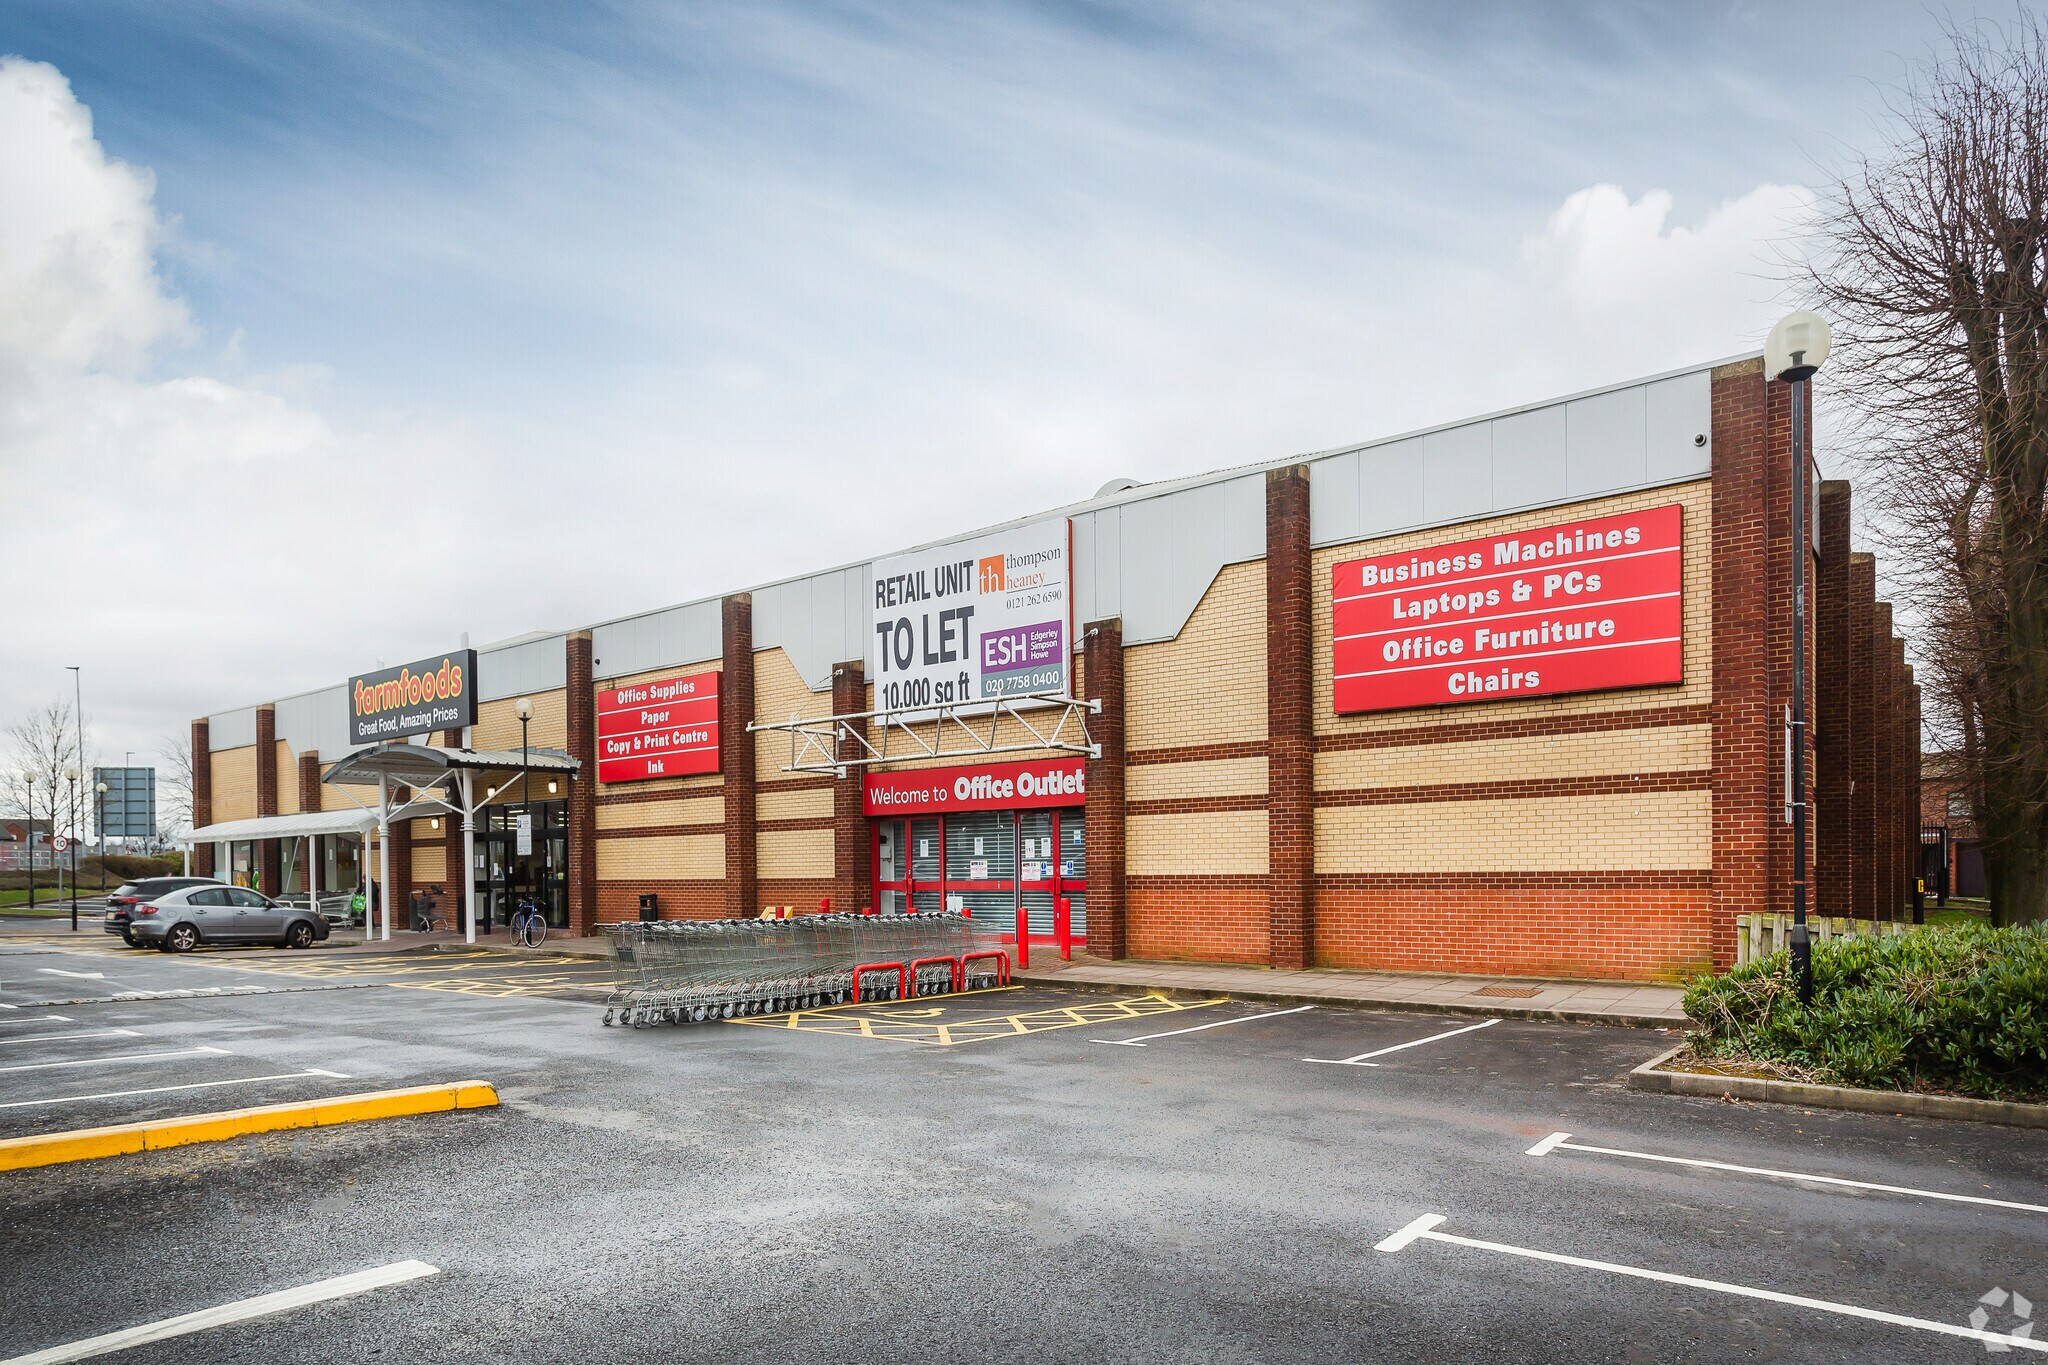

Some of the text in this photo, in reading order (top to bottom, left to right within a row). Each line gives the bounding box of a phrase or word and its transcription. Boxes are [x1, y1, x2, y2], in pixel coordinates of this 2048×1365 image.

[1006, 548, 1061, 569] thompson
[1362, 526, 1641, 587] Business Machines
[876, 560, 973, 609] RETAIL UNIT
[979, 565, 1000, 594] th
[1006, 572, 1045, 589] heaney
[1006, 590, 1062, 609] 0121 262 6590
[1393, 570, 1601, 620] Laptops & PCs
[876, 605, 974, 672] TO LET
[1030, 628, 1058, 641] Edgerley
[1030, 639, 1058, 651] Simpson
[1382, 618, 1615, 663] Office Furniture
[985, 633, 1027, 667] ESH
[1030, 650, 1049, 660] Howe
[354, 658, 462, 716] farmfoods
[617, 681, 695, 704] Office Supplies
[935, 681, 954, 711] sq
[958, 671, 970, 701] ft
[986, 670, 1060, 693] 020 7758 0400
[1448, 668, 1540, 696] Chairs
[358, 707, 458, 737] Great Food, Amazing Prices
[641, 711, 670, 726] Paper
[607, 730, 708, 755] Copy & Print Centre
[647, 759, 664, 774] Ink
[870, 768, 1085, 805] Welcome to Office Outlet
[56, 840, 65, 848] 10
